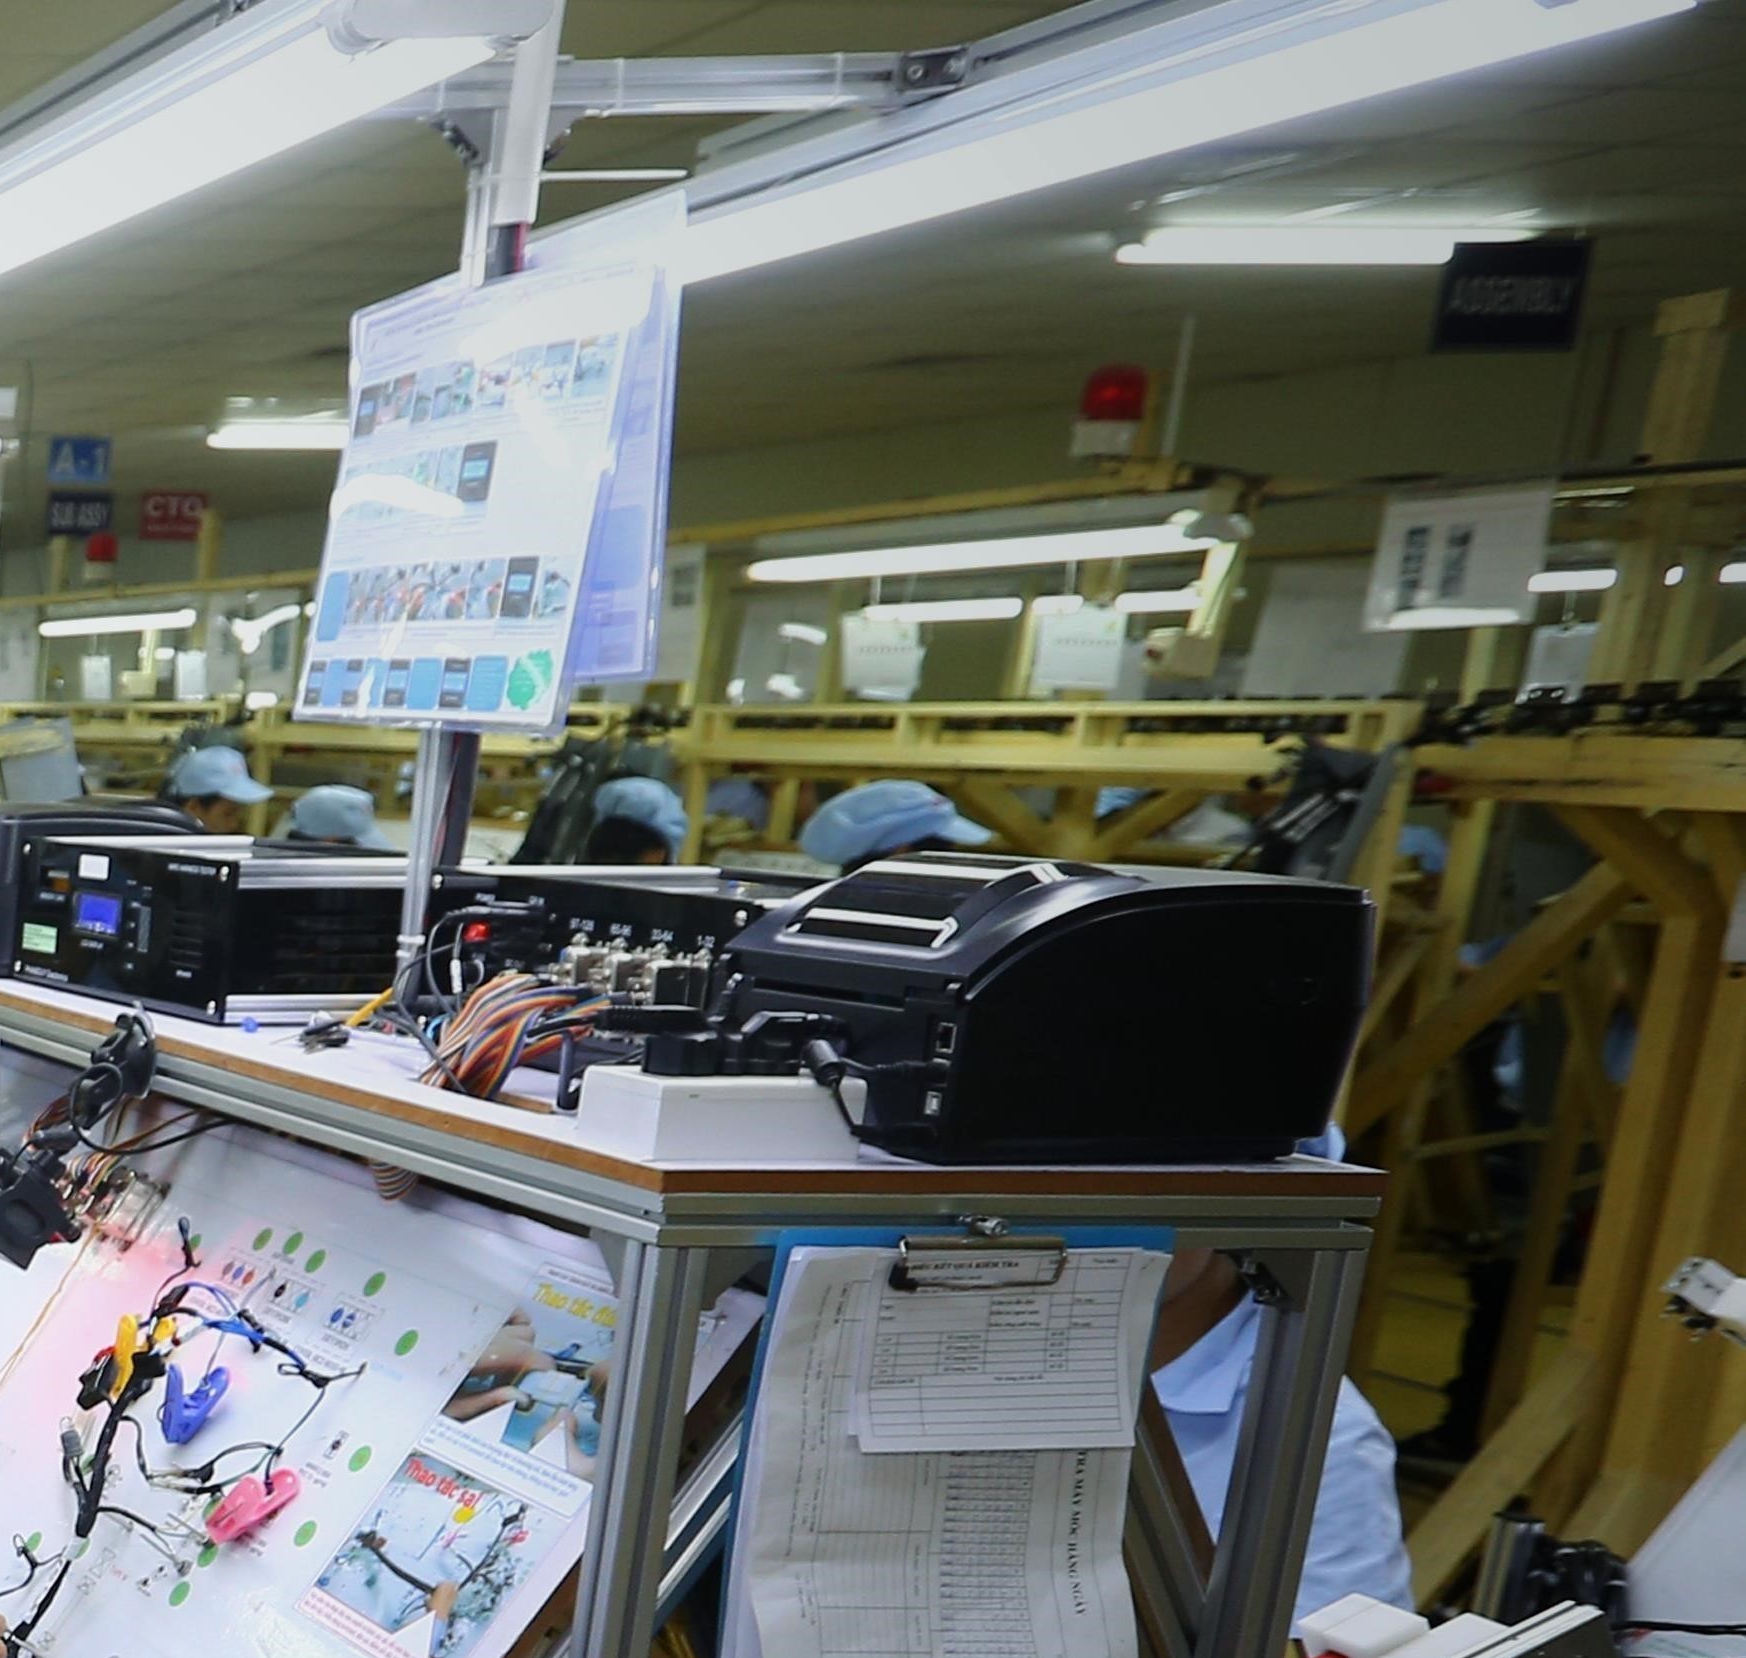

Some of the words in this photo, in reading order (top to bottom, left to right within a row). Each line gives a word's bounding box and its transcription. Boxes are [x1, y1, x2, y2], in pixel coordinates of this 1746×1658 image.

[55, 441, 108, 475] A-1
[532, 1281, 567, 1311] Thao
[565, 1296, 592, 1320] tác
[404, 1458, 437, 1488] Thao
[435, 1470, 461, 1500] tác
[457, 1484, 485, 1508] sai
